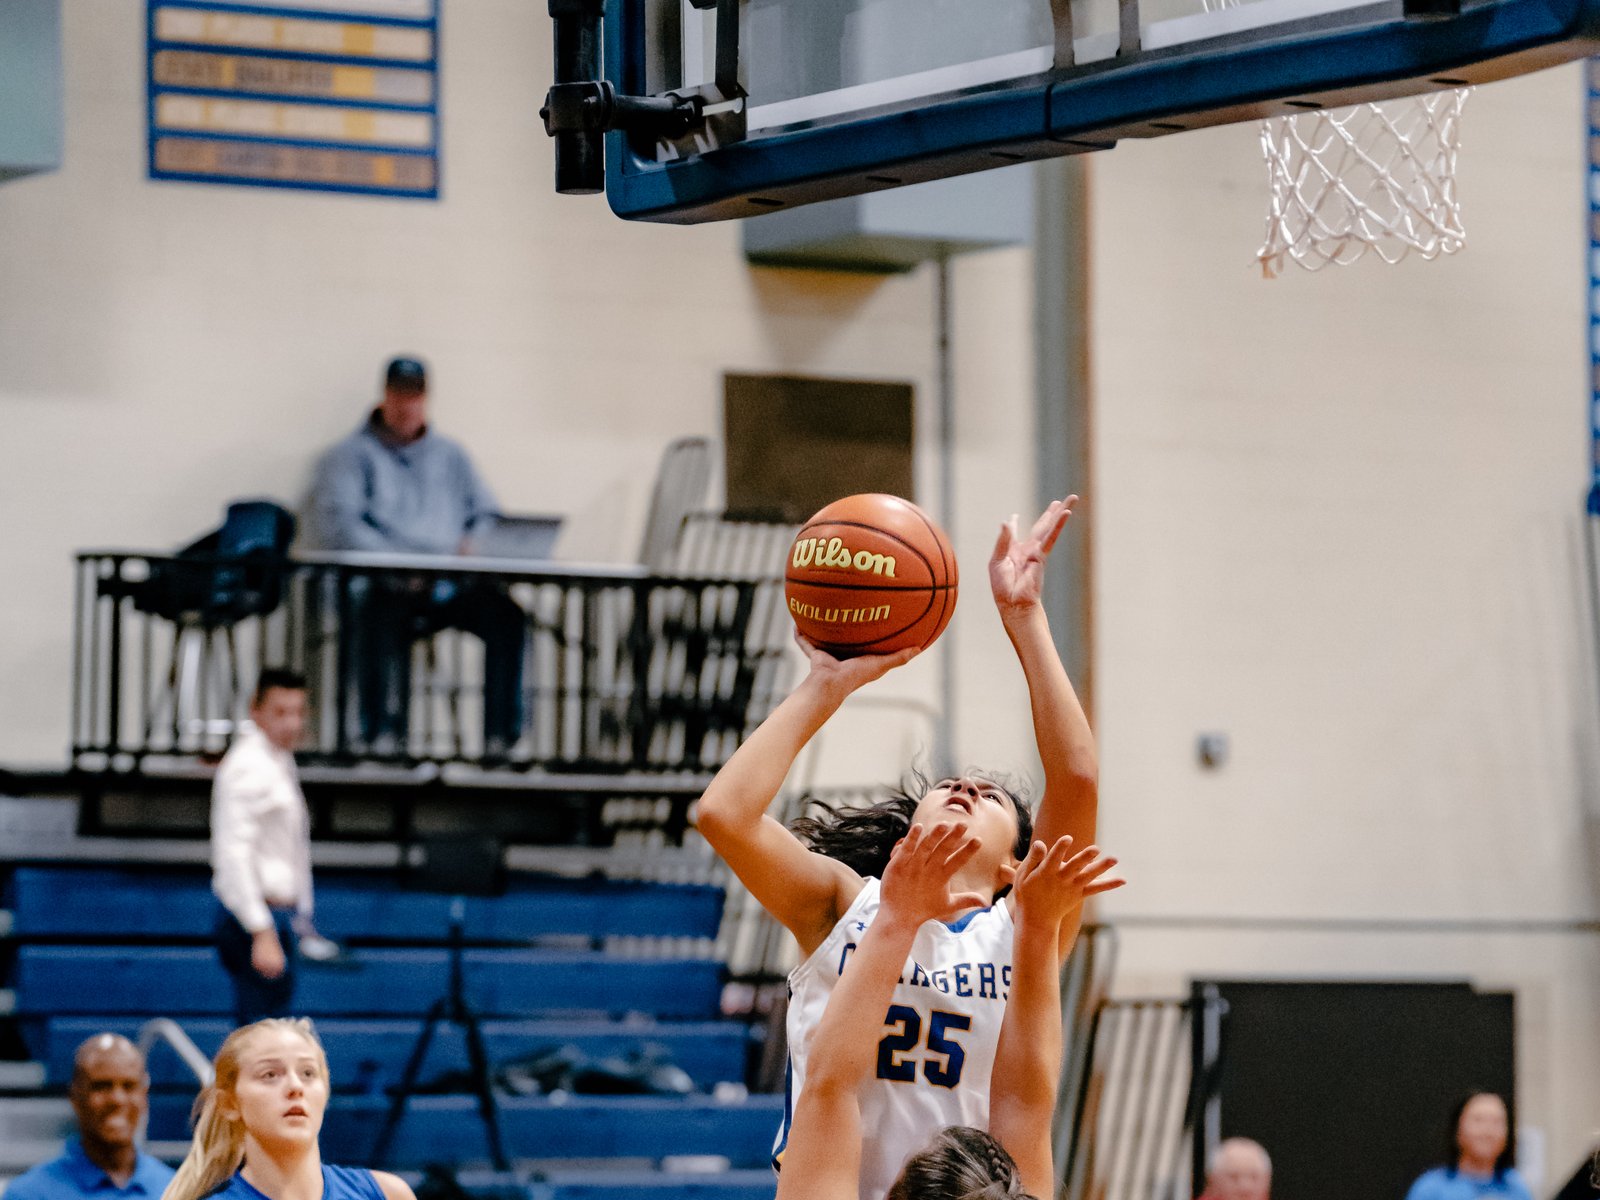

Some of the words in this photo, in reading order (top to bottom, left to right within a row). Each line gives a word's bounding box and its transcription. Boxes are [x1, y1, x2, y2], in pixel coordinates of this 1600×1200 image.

[792, 537, 896, 578] Wilson
[790, 597, 891, 623] EVOLUTION
[876, 1004, 972, 1089] 25
